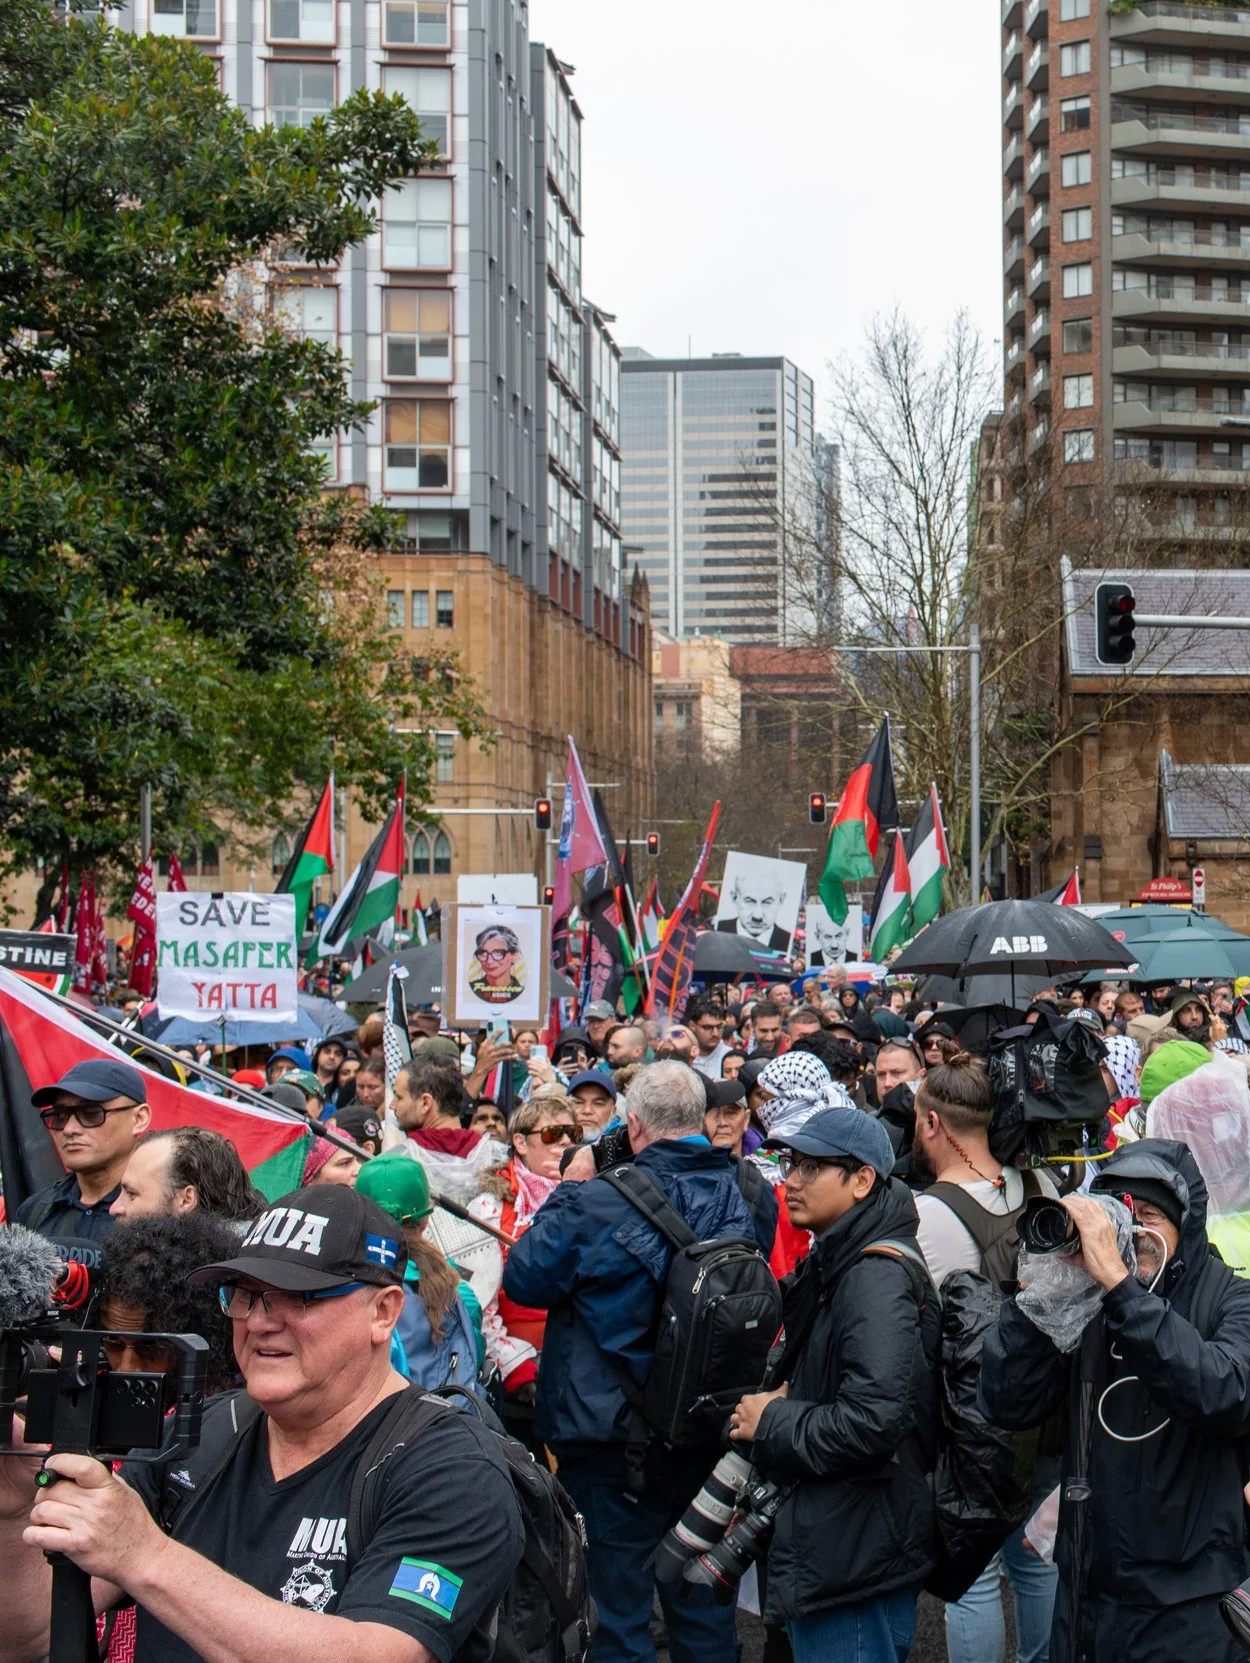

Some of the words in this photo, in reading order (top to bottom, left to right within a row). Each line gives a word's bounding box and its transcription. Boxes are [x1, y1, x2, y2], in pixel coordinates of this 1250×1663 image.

[179, 900, 270, 928] SAVE
[157, 940, 293, 969] MASAFER
[989, 935, 1048, 955] ABB
[191, 982, 277, 1009] YATTA
[241, 1207, 330, 1256] MUA
[289, 1517, 348, 1554] MUA
